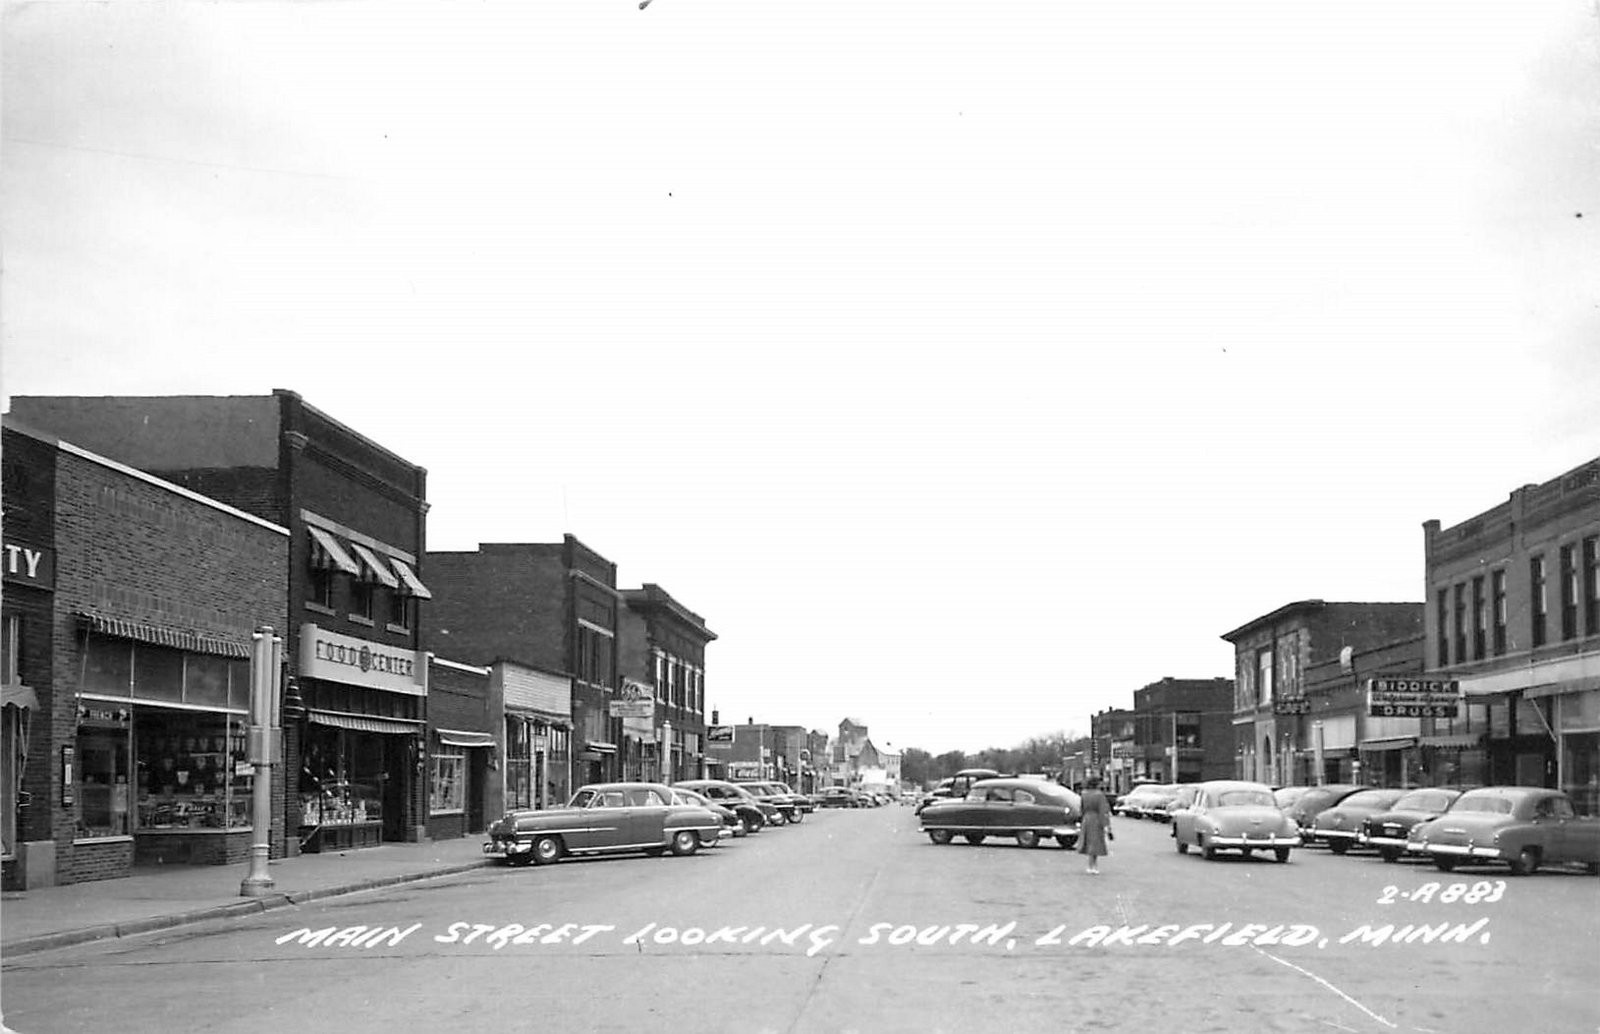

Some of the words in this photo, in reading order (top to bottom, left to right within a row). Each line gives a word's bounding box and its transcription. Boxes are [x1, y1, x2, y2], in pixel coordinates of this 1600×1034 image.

[316, 639, 361, 668] FOOD
[370, 652, 415, 677] CENTER
[1378, 680, 1452, 692] BIDDICK
[1383, 705, 1446, 717] DRUGS
